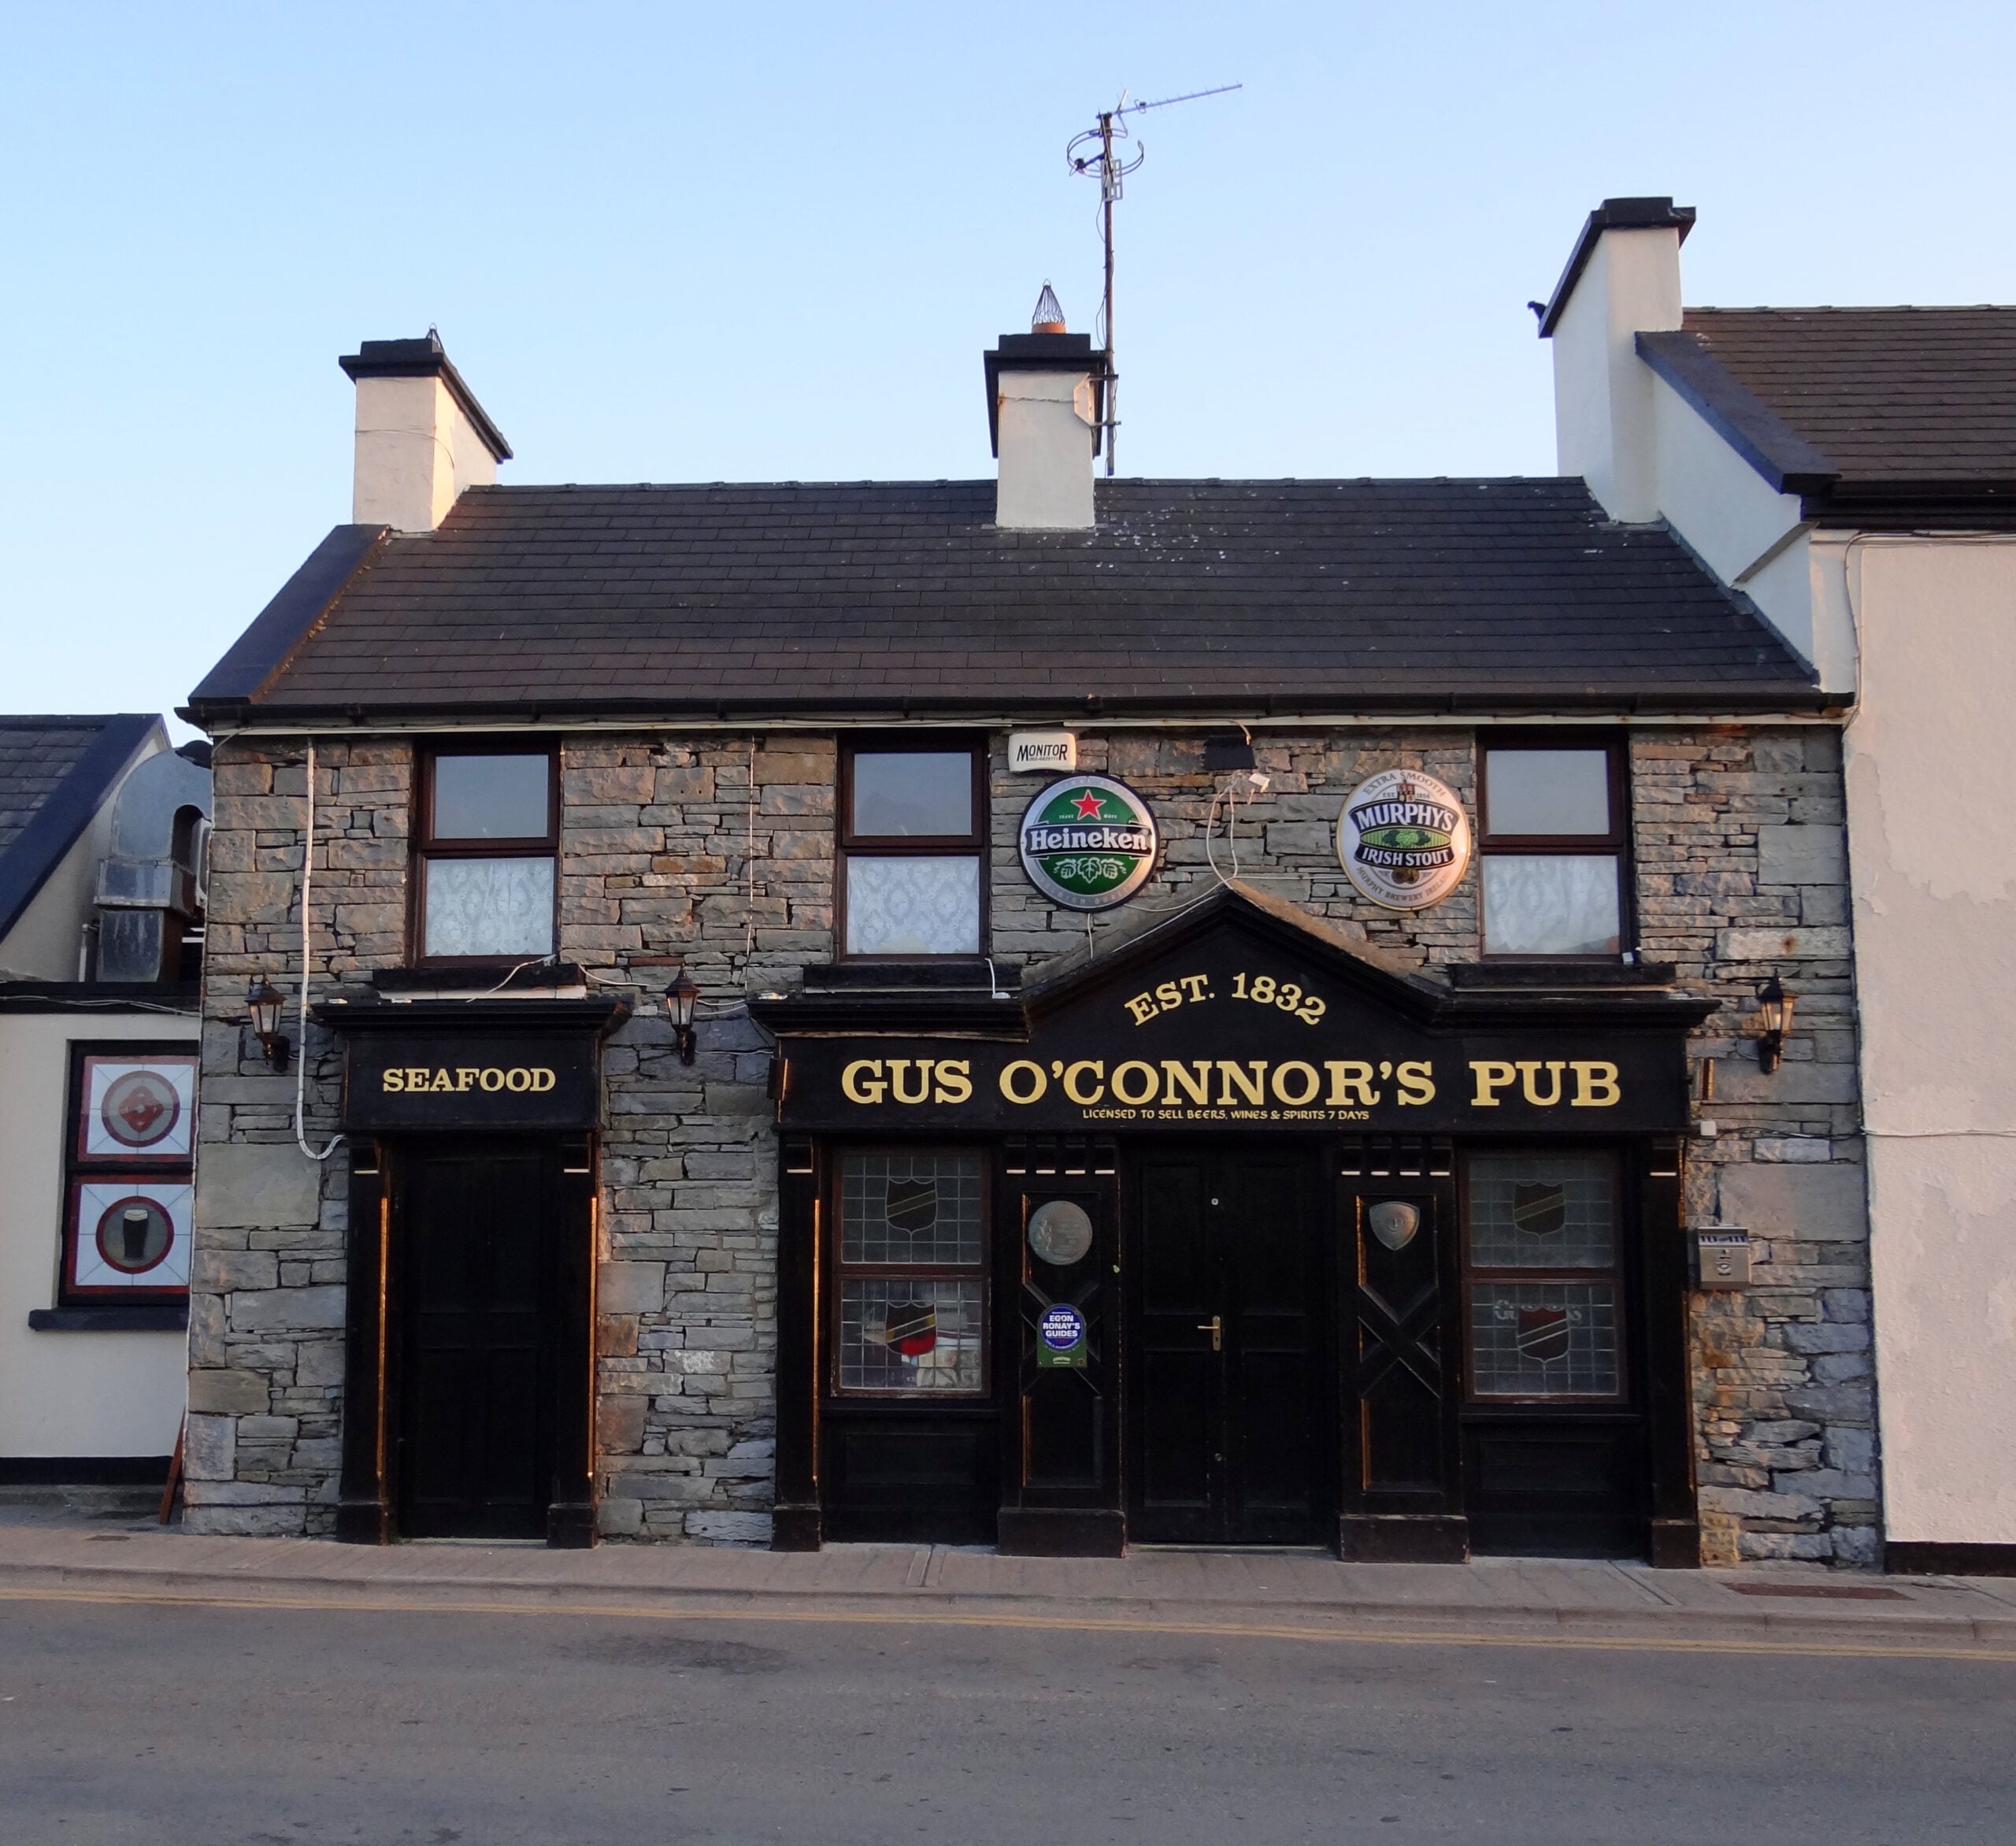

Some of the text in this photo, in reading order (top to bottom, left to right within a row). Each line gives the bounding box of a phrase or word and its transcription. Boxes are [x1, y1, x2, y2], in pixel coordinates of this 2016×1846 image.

[1017, 743, 1068, 762] MONITOR
[1362, 771, 1447, 798] EXTRA SMOOTH
[1355, 803, 1454, 832] MURPHY'S
[1030, 828, 1147, 851] Heineken
[1361, 847, 1449, 866] IRISH STOUT
[1124, 972, 1327, 1026] EST. 1832
[383, 1067, 557, 1092] SEAFOOD
[841, 1059, 1621, 1107] GUS O'CONNOR'S PUB
[1082, 1109, 1136, 1119] LICENSED
[1140, 1109, 1155, 1119] TO
[1158, 1110, 1184, 1119] SELL
[1231, 1110, 1268, 1120] WINES
[1269, 1110, 1280, 1120] &
[1283, 1110, 1325, 1120] SPIRITS
[1328, 1110, 1336, 1120] 7
[1338, 1110, 1369, 1120] DAYS
